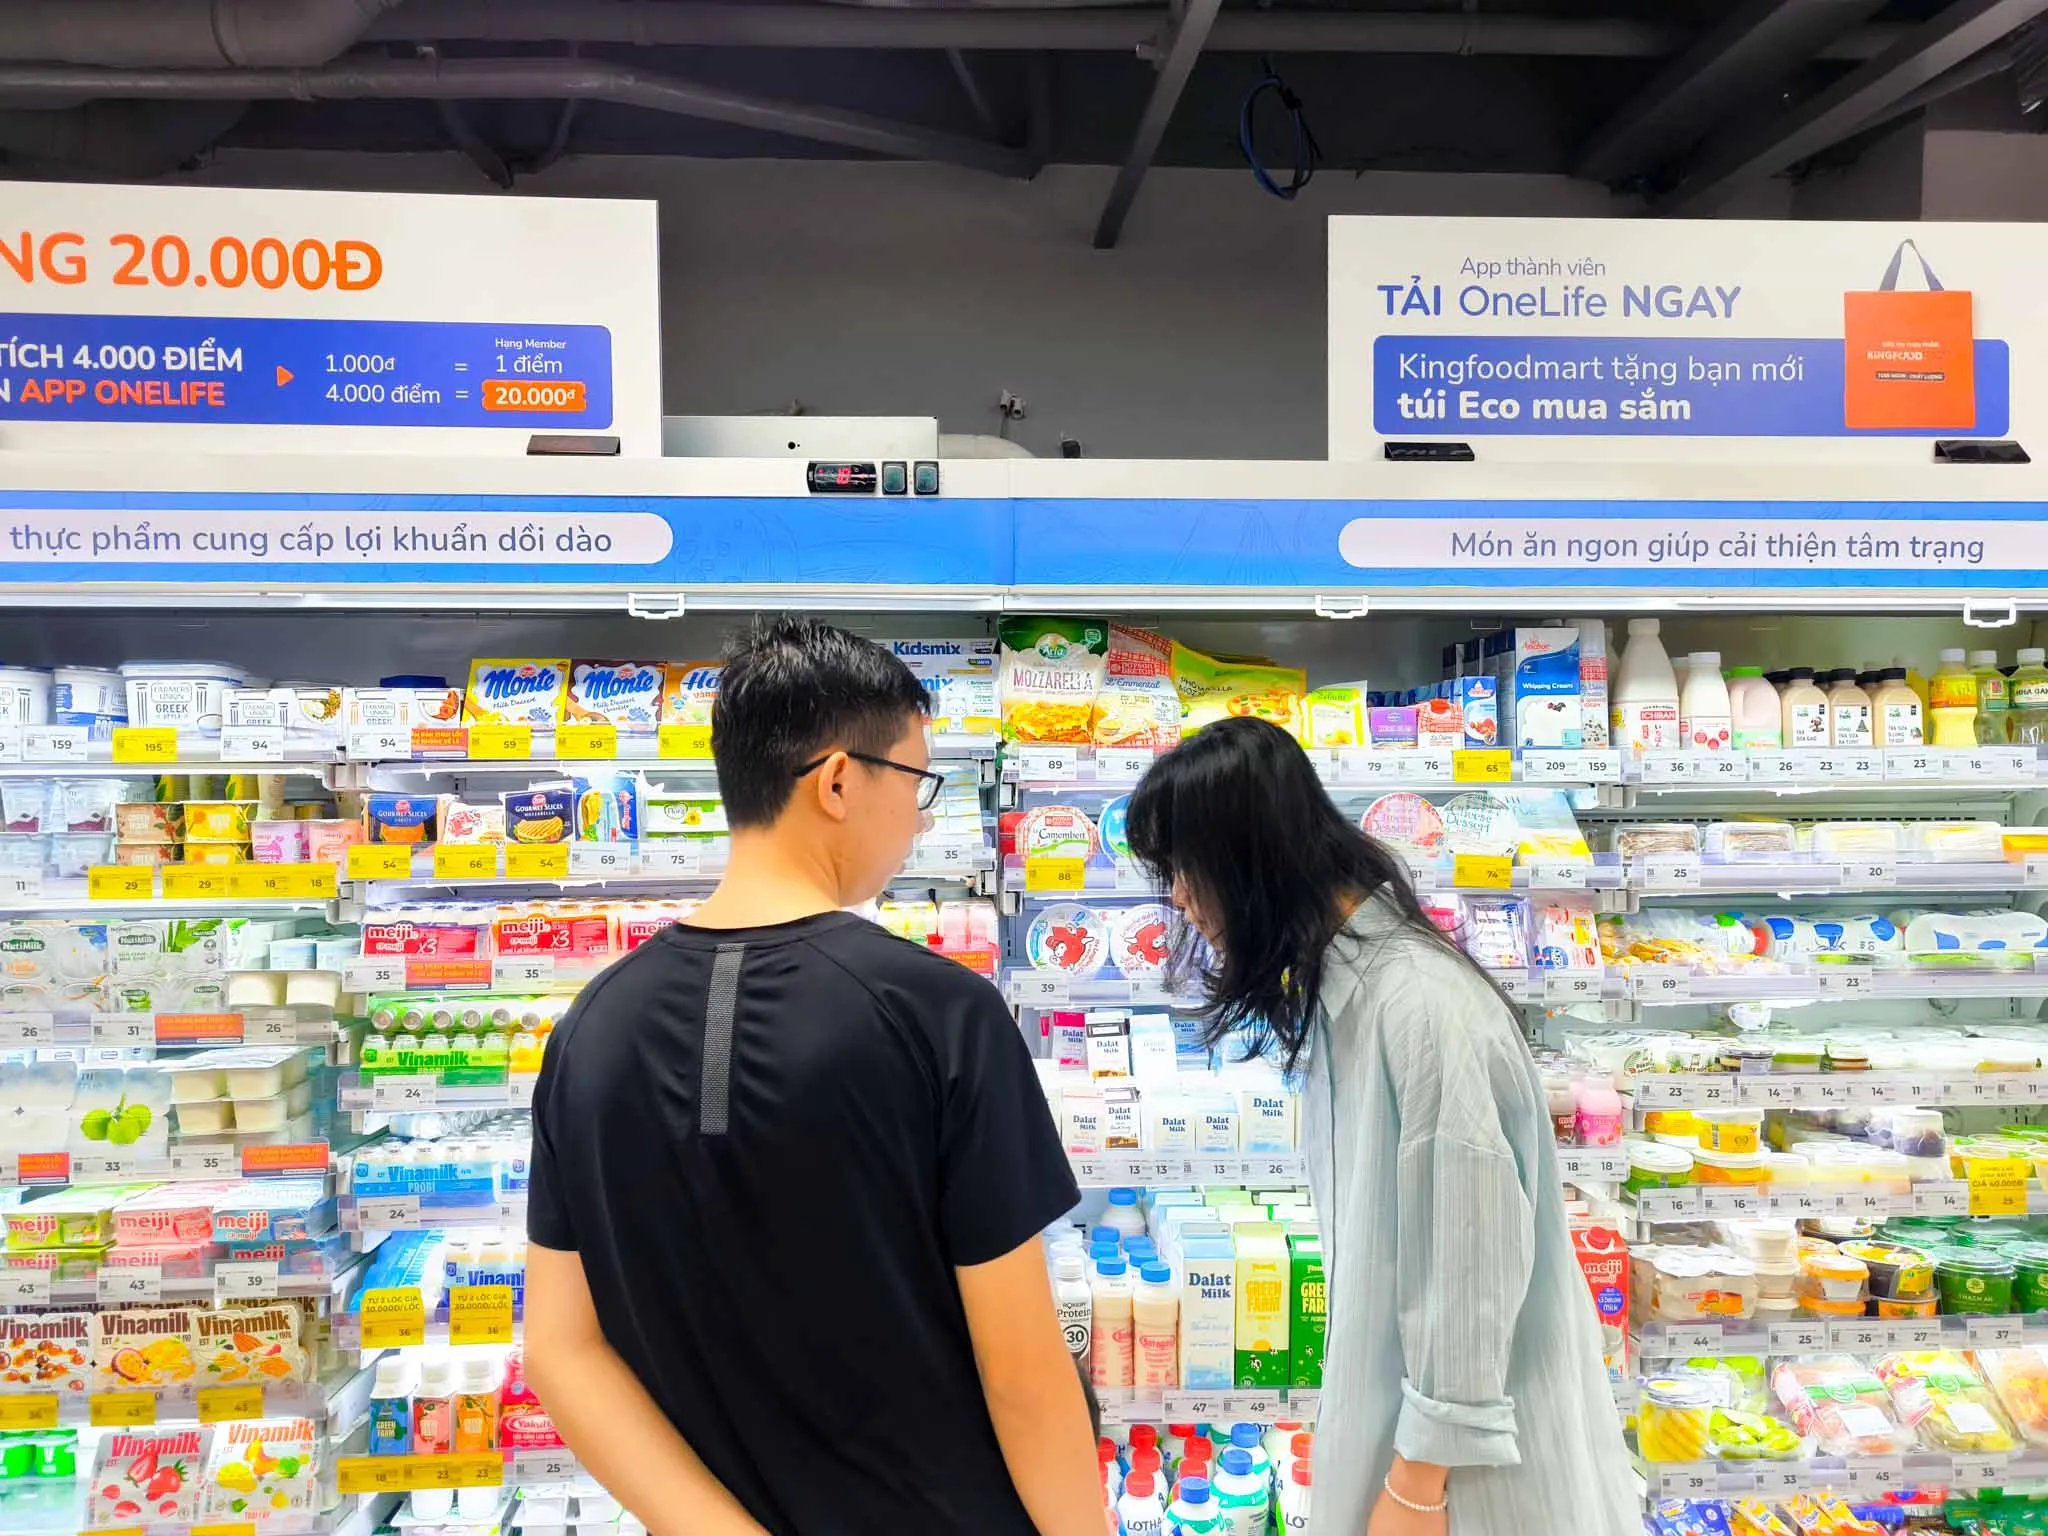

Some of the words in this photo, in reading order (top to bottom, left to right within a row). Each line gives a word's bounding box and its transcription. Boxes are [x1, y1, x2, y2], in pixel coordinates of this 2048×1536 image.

[112, 234, 383, 291] 20.000Đ
[1460, 257, 1501, 280] App
[1505, 256, 1561, 277] thành
[1566, 257, 1606, 276] viên
[1377, 276, 1441, 316] TẢI
[1459, 283, 1608, 318] OneLife
[1623, 286, 1741, 319] NGAY
[495, 338, 522, 351] Hạng
[525, 339, 567, 350] Member
[73, 344, 154, 370] 4.000
[162, 338, 243, 372] ĐIỂM
[325, 355, 395, 372] 1.000đ
[496, 356, 506, 372] 1
[513, 355, 562, 374] điểm
[1399, 353, 1603, 387] Kingfoodmart
[1610, 355, 1677, 387] tặng
[1689, 354, 1741, 388] bạn
[1752, 354, 1805, 382] mới
[20, 379, 86, 403] APP
[95, 381, 225, 406] ONELIFE
[325, 384, 384, 403] 4.000
[391, 384, 441, 405] điểm
[495, 387, 576, 407] 20.000đ
[1397, 391, 1446, 420] túi
[1459, 392, 1519, 421] Eco
[1532, 397, 1607, 421] mua
[1620, 390, 1691, 422] sắm
[10, 524, 81, 558] thực
[93, 523, 182, 560] phẩm
[192, 530, 268, 558] cung
[279, 522, 334, 557] cấp
[345, 524, 382, 557] lợi
[393, 523, 487, 552] khuẩn
[498, 523, 545, 553] dồi
[555, 524, 612, 553] dào
[1451, 530, 1513, 560] Món
[1523, 532, 1557, 558] ăn
[1566, 537, 1638, 566] ngon
[1648, 532, 1708, 565] giúp
[1719, 532, 1757, 559] cải
[1766, 532, 1836, 564] thiện
[1846, 531, 1900, 559] tâm
[1909, 532, 1984, 565] trạng
[894, 641, 960, 655] Kidsmix
[484, 669, 554, 699] Monte
[1013, 668, 1092, 690] MOZZARELLA
[583, 669, 654, 700] Monte
[1523, 682, 1550, 690] Whipping
[155, 703, 188, 713] GREEK
[52, 740, 72, 749] 159
[380, 738, 396, 748] 94
[590, 740, 602, 749] 59
[1368, 763, 1381, 771] 79
[1546, 762, 1565, 770] 209
[1671, 763, 1684, 771] 36
[1820, 762, 1832, 770] 23
[1914, 760, 1926, 768] 23
[1038, 828, 1085, 839] Camembert
[671, 855, 684, 864] 75
[16, 882, 25, 890] 11
[502, 919, 544, 934] meiji
[368, 925, 413, 940] meiji
[551, 930, 569, 947] x3
[3, 941, 42, 950] NutiMilk
[525, 969, 538, 978] 35
[1574, 982, 1587, 990] 59
[22, 1027, 37, 1037] 26
[266, 1024, 280, 1032] 26
[398, 1050, 468, 1066] Vinamilk
[1669, 1088, 1681, 1096] 23
[1768, 1088, 1780, 1097] 14
[1871, 1087, 1883, 1096] 14
[2029, 1085, 2036, 1093] 11
[1253, 1098, 1284, 1108] Dalat
[1108, 1107, 1131, 1115] Dalat
[1262, 1108, 1283, 1117] Milk
[1073, 1116, 1097, 1124] Dalat
[1162, 1118, 1186, 1126] Dalat
[1206, 1116, 1229, 1124] Dalat
[1080, 1123, 1097, 1131] Milk
[1169, 1125, 1186, 1133] Milk
[203, 1158, 218, 1167] 35
[1601, 1162, 1612, 1171] 18
[388, 1165, 458, 1181] Vinamilk
[1129, 1165, 1140, 1174] 13
[1269, 1165, 1282, 1174] 26
[1734, 1200, 1745, 1209] 16
[1864, 1198, 1875, 1206] 14
[390, 1210, 405, 1219] 24
[8, 1216, 56, 1232] meiji
[120, 1212, 170, 1229] meiji
[217, 1212, 268, 1231] meiji
[234, 1245, 284, 1260] meiji
[1585, 1260, 1622, 1274] meiji
[247, 1276, 262, 1286] 39
[1189, 1273, 1232, 1287] Dalat
[1201, 1288, 1231, 1298] Milk
[1246, 1280, 1282, 1296] GREEN
[1247, 1296, 1281, 1312] FARM
[1057, 1308, 1091, 1319] Protein
[199, 1311, 291, 1336] Vinamilk
[1066, 1331, 1084, 1343] 30
[1799, 1335, 1812, 1344] 25
[1914, 1332, 1927, 1341] 27
[1250, 1402, 1265, 1411] 49
[228, 1421, 315, 1444] Vinamilk
[111, 1432, 200, 1457] Vinamilk
[1876, 1472, 1889, 1481] 45
[1689, 1477, 1703, 1487] 39
